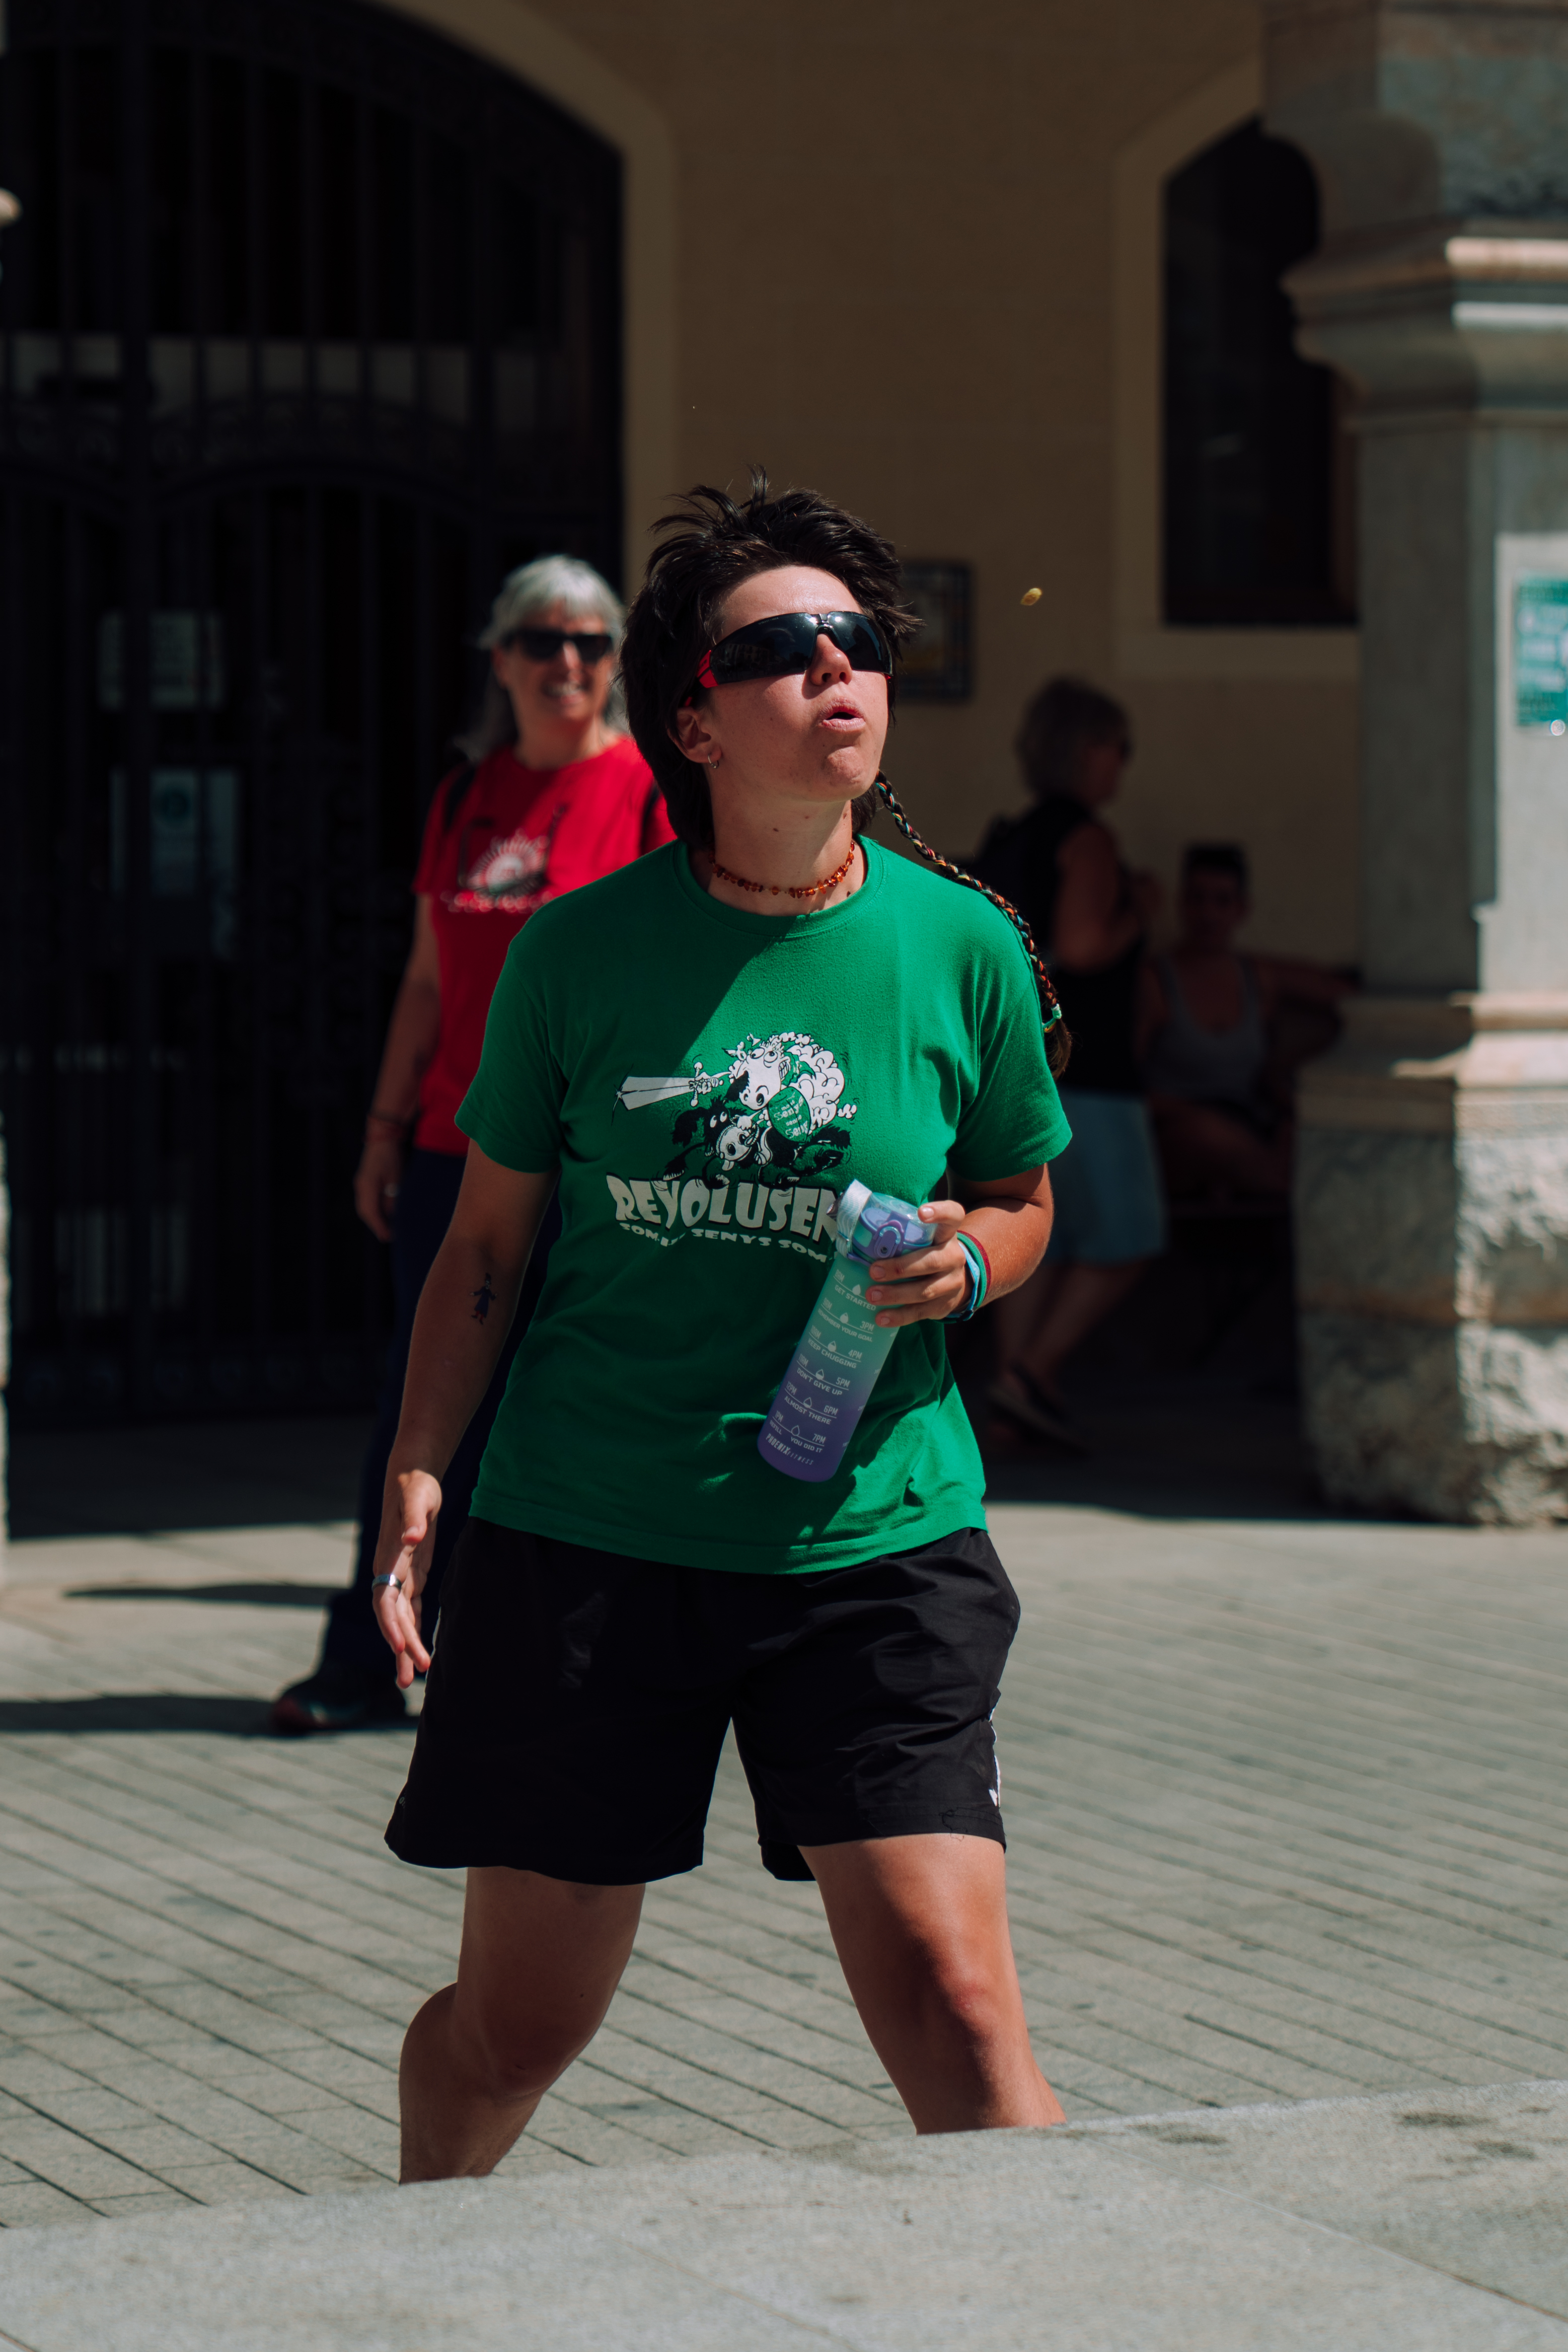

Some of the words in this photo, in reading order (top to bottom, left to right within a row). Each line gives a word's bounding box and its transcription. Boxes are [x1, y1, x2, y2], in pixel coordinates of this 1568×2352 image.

[691, 1228, 772, 1246] SENYS
[835, 1285, 846, 1295] GET
[846, 1293, 876, 1311] STARTED
[810, 1325, 822, 1339] 10AM
[817, 1308, 841, 1329] REMEMBER
[841, 1326, 857, 1337] YOUR
[858, 1334, 873, 1342] GOAL
[860, 1321, 875, 1332] 3PM
[798, 1353, 809, 1367] 11AM
[807, 1338, 821, 1351] KEEP
[821, 1349, 857, 1369] CHUGGING
[848, 1350, 863, 1360] 4PM
[797, 1367, 813, 1382] DON'T
[813, 1380, 831, 1392] GIVE
[836, 1377, 851, 1388] 5PM
[786, 1381, 797, 1395] 12PM
[775, 1410, 784, 1423] 1PM
[784, 1395, 807, 1415] ALMOST
[808, 1411, 832, 1425] THERE
[824, 1405, 839, 1416] 6PM
[769, 1420, 782, 1435] REFILL
[791, 1436, 803, 1446] YOU
[803, 1443, 815, 1451] DID
[812, 1433, 826, 1444] 7PM
